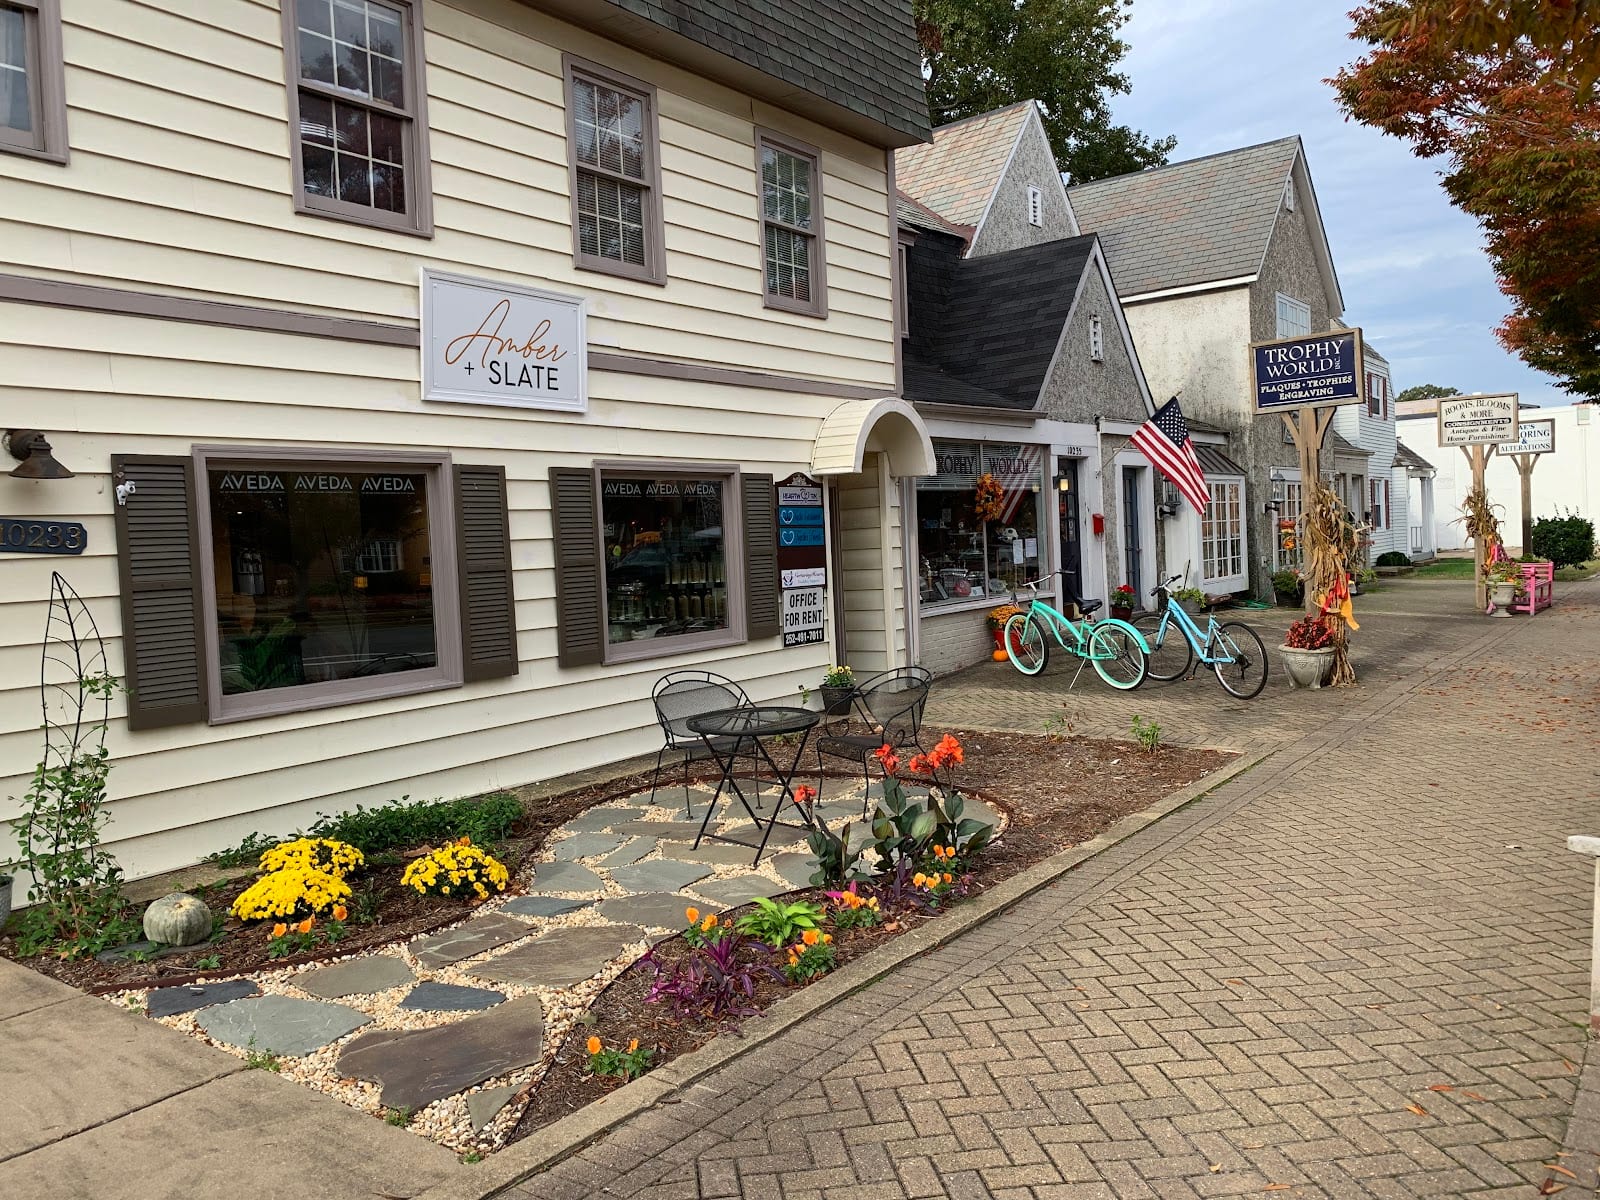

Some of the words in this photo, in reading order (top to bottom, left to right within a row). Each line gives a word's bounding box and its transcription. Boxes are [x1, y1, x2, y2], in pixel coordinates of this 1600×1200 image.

[445, 299, 568, 369] Amber
[1264, 339, 1345, 364] TROPHY
[488, 360, 559, 391] SLATE
[1266, 357, 1333, 378] WORLD
[1261, 382, 1301, 394] PLAQUES
[1306, 375, 1353, 388] TROPHIES
[1279, 387, 1333, 400] ENGRAVING
[1469, 409, 1494, 419] MORE
[1475, 399, 1512, 412] BLOOMS
[1500, 442, 1551, 453] ALTERATIONS
[219, 474, 285, 491] AVEDA
[294, 475, 353, 491] AVEDA
[361, 477, 416, 492] AVEDA
[604, 482, 642, 496] AVEDA
[645, 483, 681, 496] AVEDA
[683, 484, 717, 496] AVEDA
[0, 523, 83, 550] 10233
[789, 592, 818, 609] OFFICE
[784, 612, 800, 628] FOR
[802, 609, 823, 625] RENT
